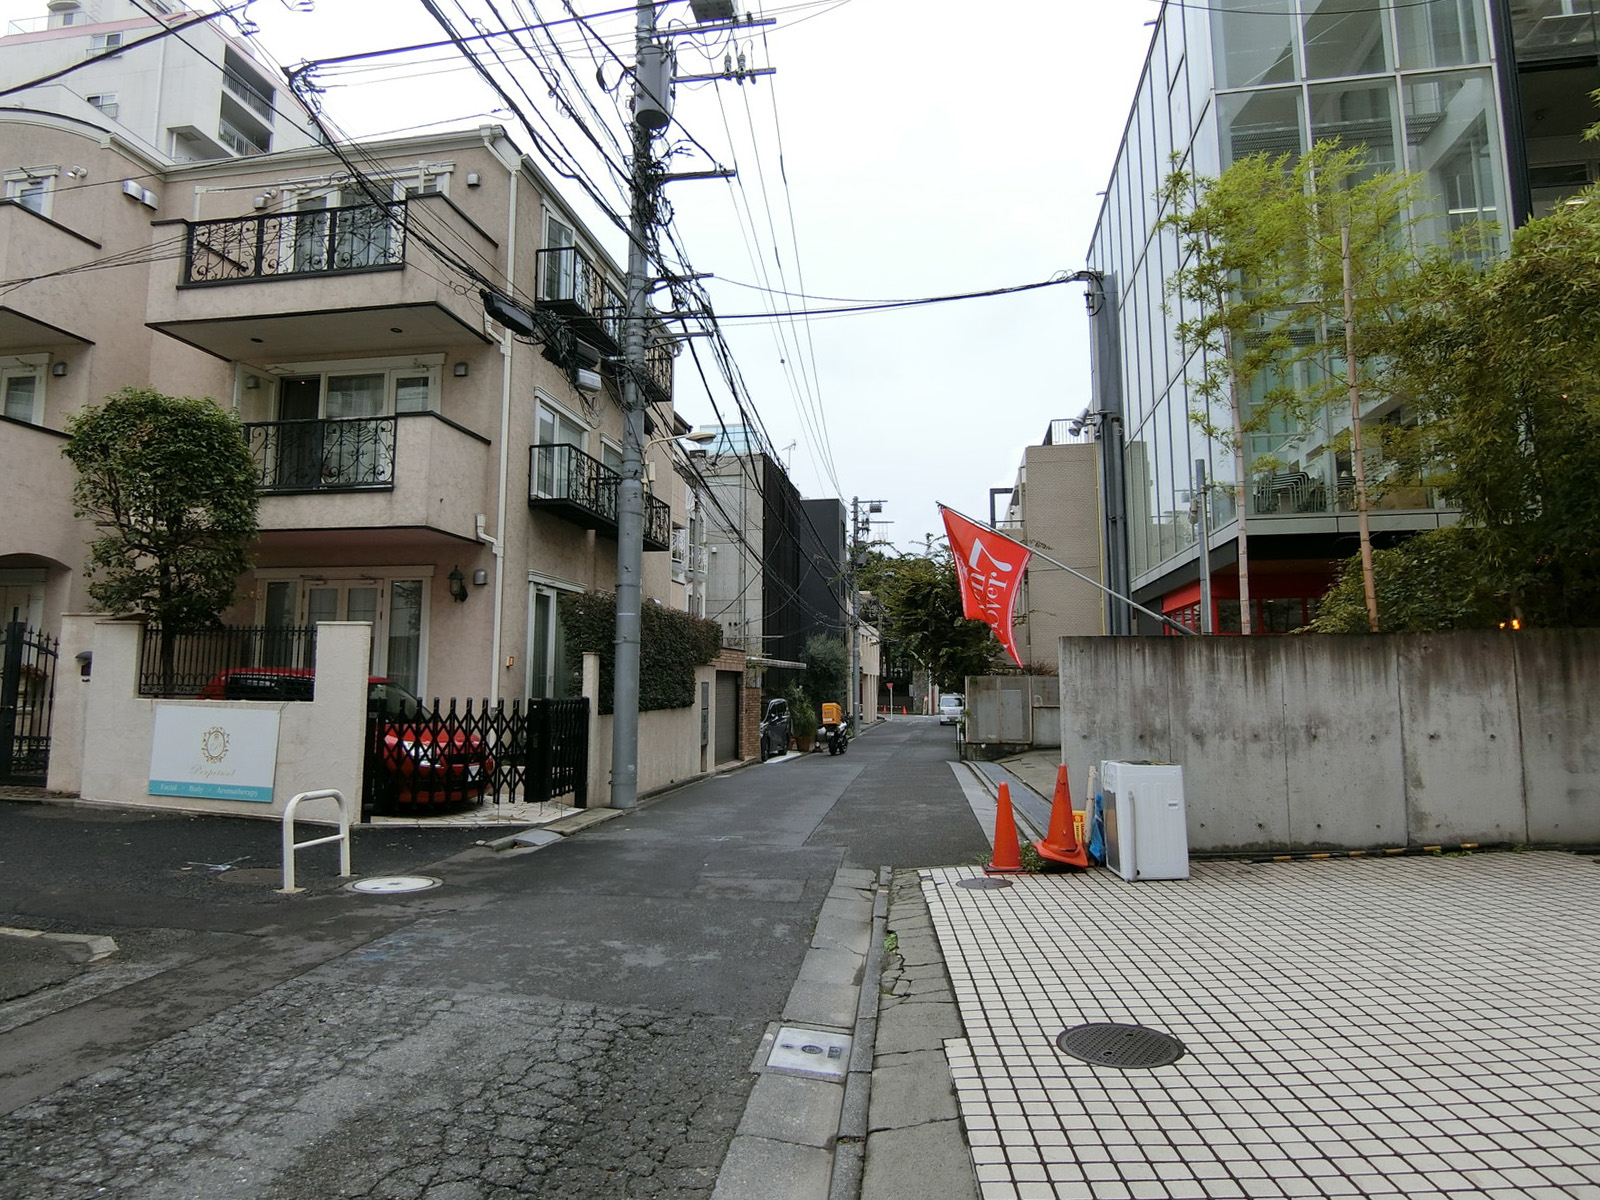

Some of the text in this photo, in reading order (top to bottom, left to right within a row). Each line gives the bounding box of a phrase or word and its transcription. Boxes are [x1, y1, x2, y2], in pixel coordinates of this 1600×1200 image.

[160, 783, 259, 798] Facial Body Aromatherapy
